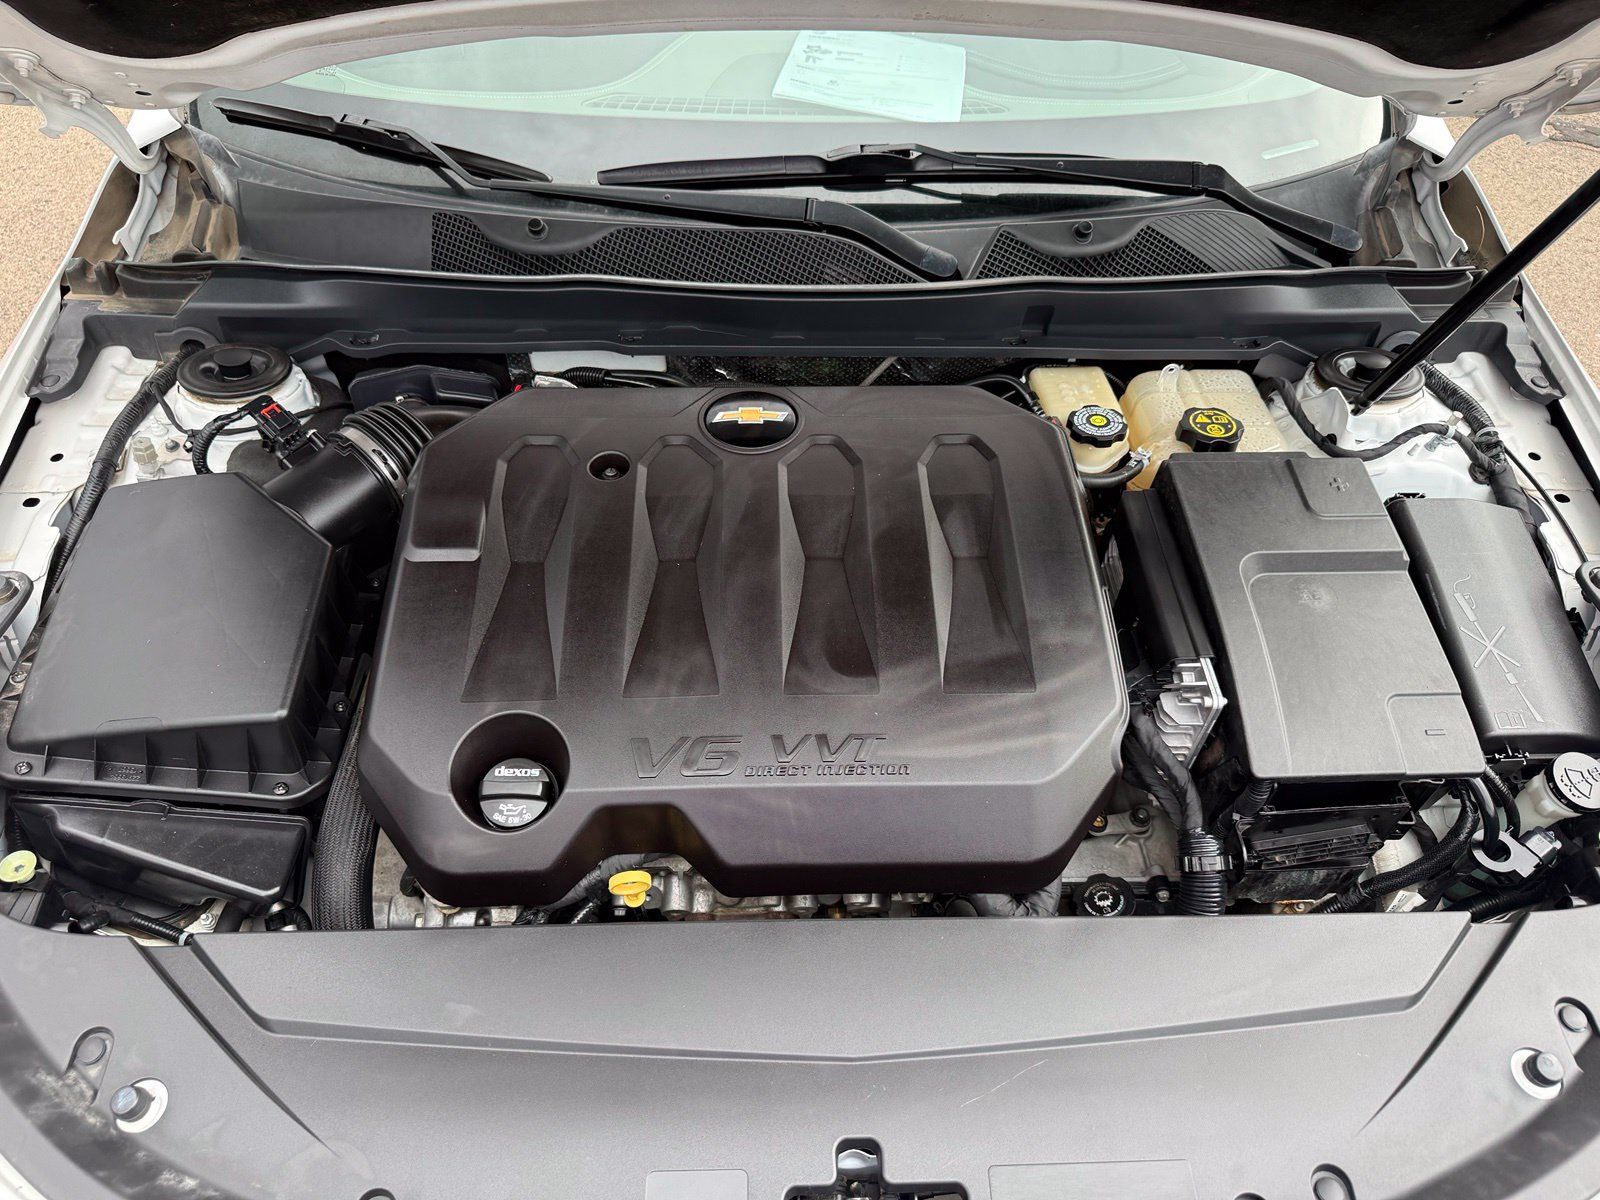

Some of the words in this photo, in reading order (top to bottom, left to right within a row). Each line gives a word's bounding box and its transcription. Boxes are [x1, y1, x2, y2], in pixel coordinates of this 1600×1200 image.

[630, 736, 743, 778] V6
[771, 733, 887, 763] VVT
[494, 765, 541, 777] dexos
[745, 765, 811, 777] DIRECT
[817, 763, 911, 776] INJECTION
[493, 812, 507, 823] SAE
